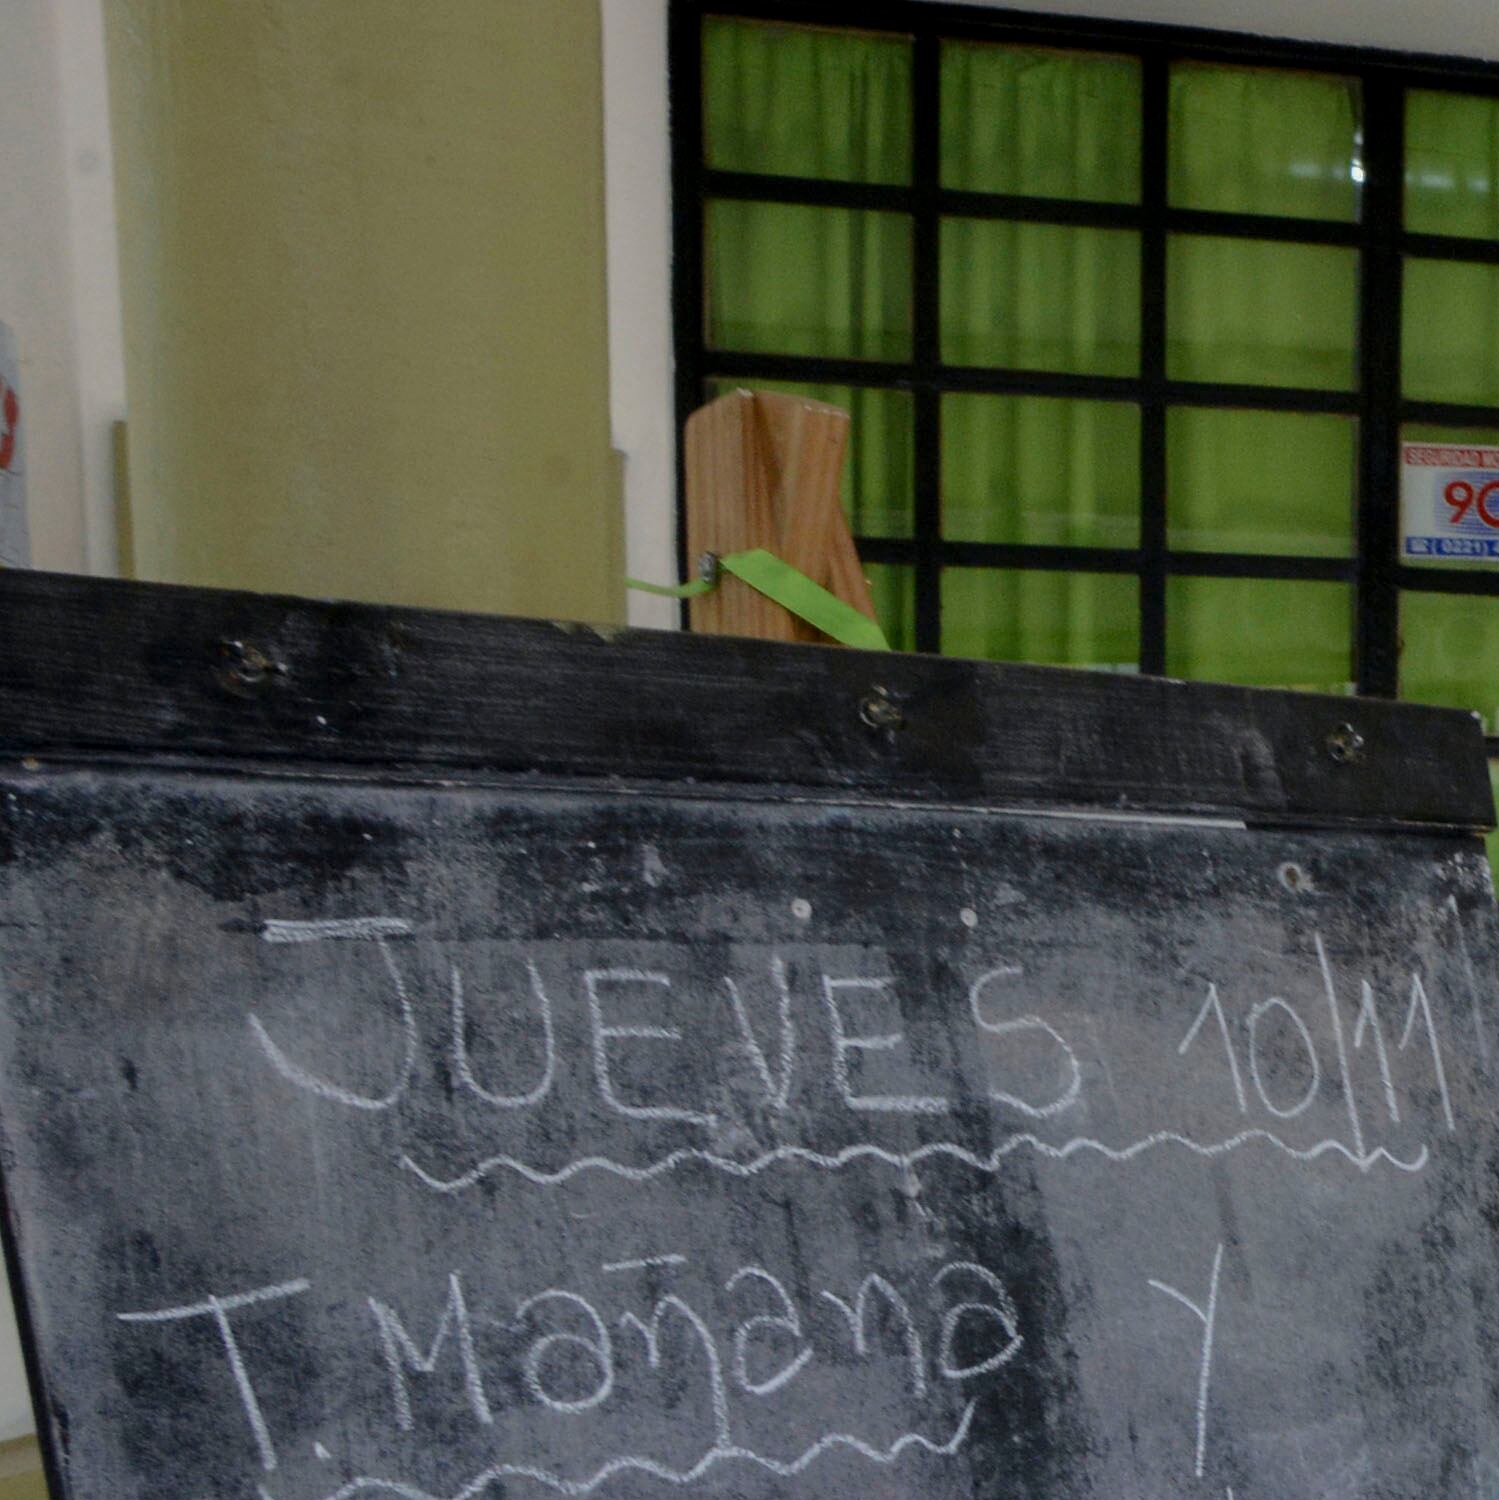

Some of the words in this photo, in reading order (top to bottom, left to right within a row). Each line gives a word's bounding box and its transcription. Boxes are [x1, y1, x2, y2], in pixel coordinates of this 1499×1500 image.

[247, 915, 1084, 1124] JUEVES
[1178, 930, 1456, 1172] 10/11
[1149, 1242, 1224, 1477] Y
